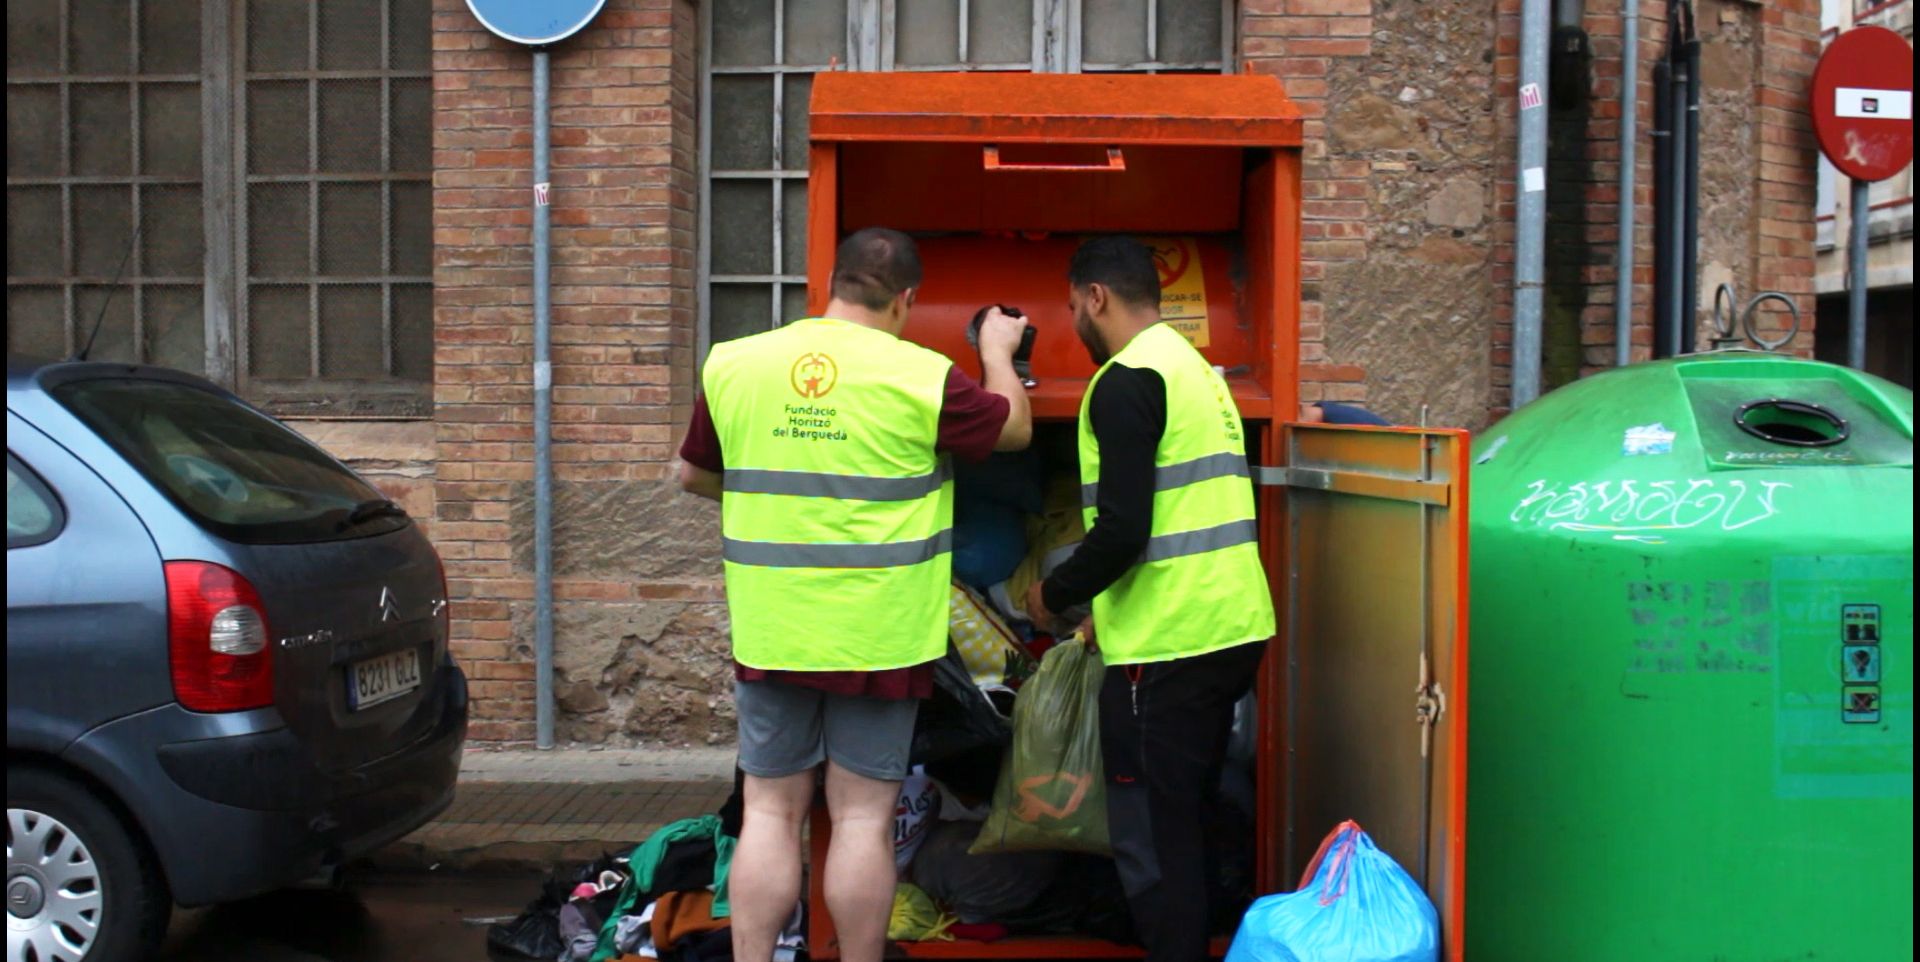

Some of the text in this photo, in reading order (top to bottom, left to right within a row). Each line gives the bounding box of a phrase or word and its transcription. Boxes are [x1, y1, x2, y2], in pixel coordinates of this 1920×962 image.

[773, 427, 789, 437] del
[359, 651, 418, 698] 8231 GLZ
